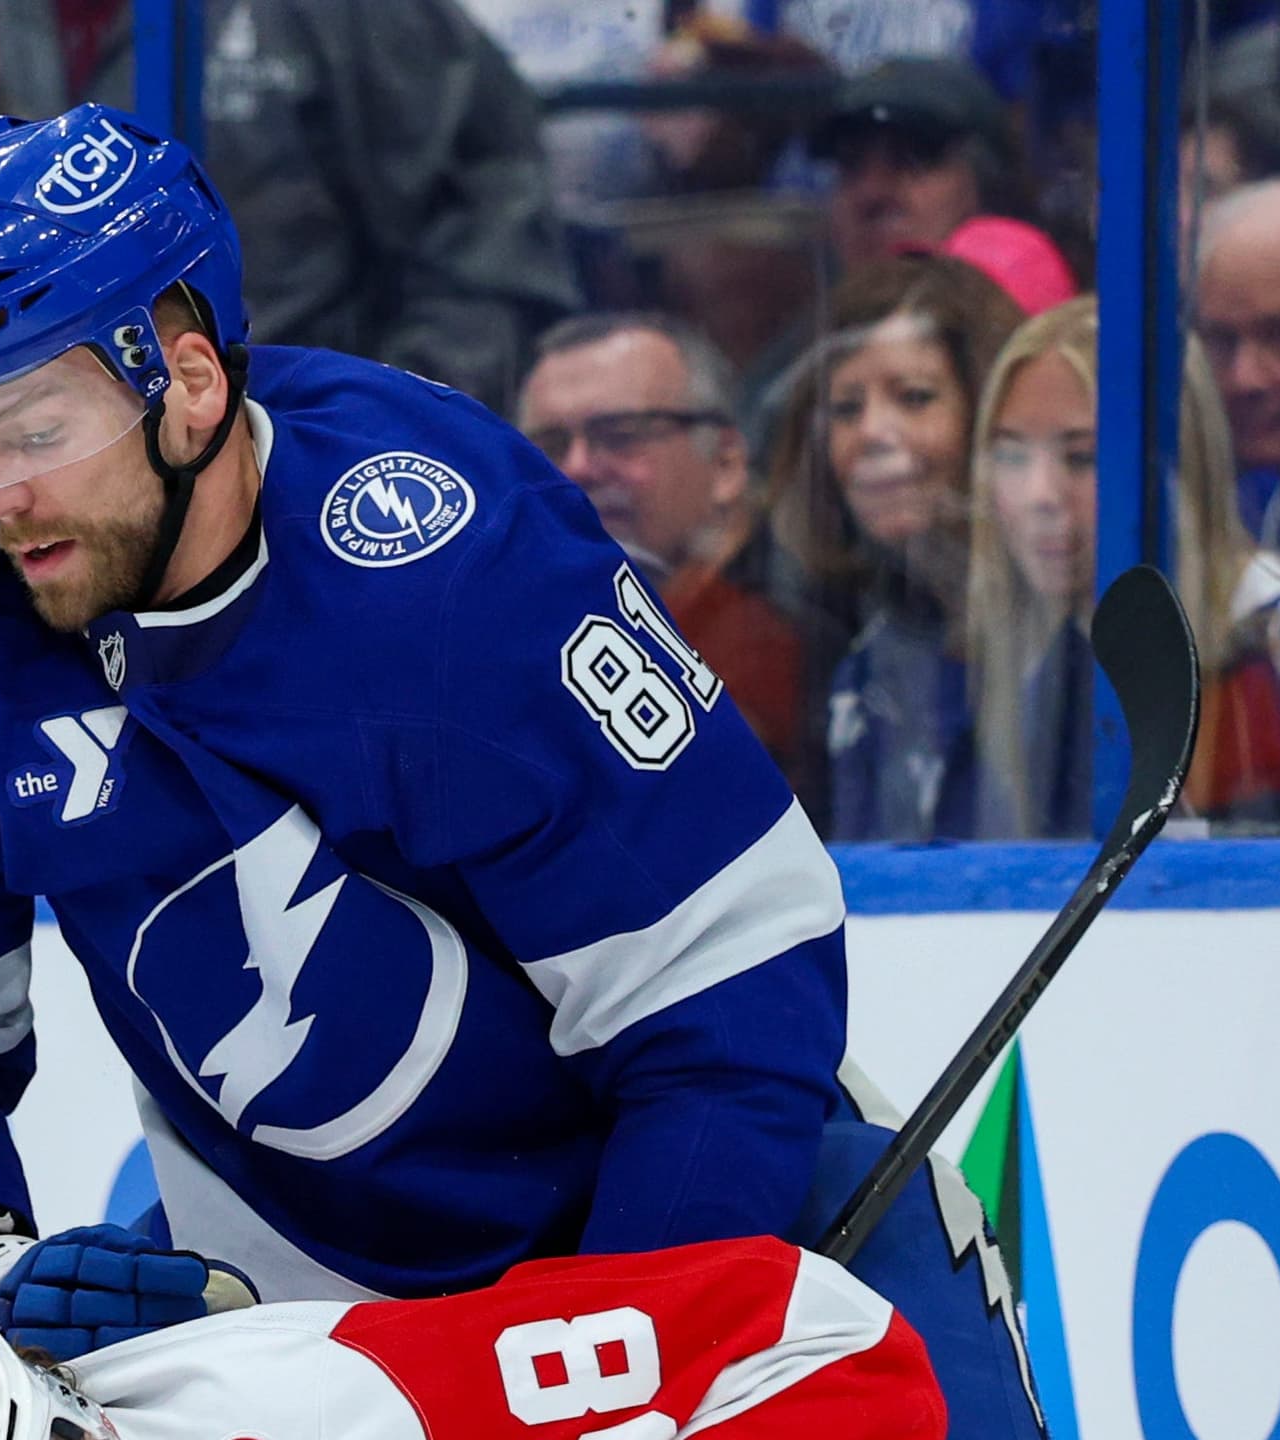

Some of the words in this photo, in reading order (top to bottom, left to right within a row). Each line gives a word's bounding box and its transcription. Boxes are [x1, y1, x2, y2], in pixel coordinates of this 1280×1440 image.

[35, 118, 133, 199] TGH
[344, 458, 457, 493] LIGHTNING
[331, 495, 350, 529] BAY
[339, 528, 407, 557] TAMPA
[560, 560, 724, 771] 81
[14, 771, 59, 799] the
[96, 778, 115, 809] YMCA
